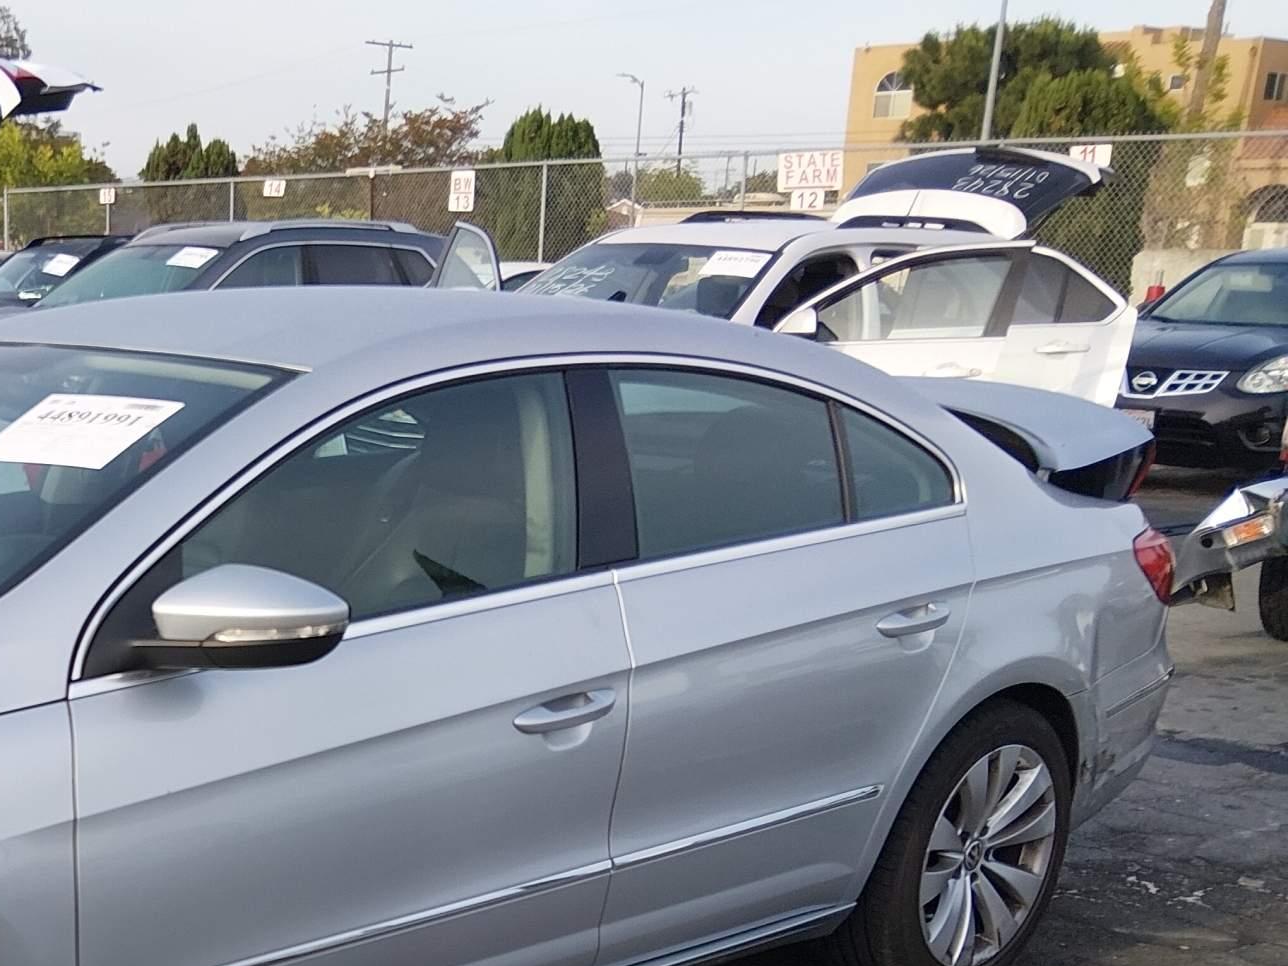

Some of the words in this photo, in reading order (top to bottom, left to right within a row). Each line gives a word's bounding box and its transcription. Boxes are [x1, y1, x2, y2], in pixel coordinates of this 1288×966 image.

[783, 152, 841, 170] STATE
[454, 177, 472, 191] BW
[784, 168, 838, 185] FARM
[455, 195, 470, 210] 13
[797, 191, 819, 209] 12
[37, 410, 145, 427] 44891991
